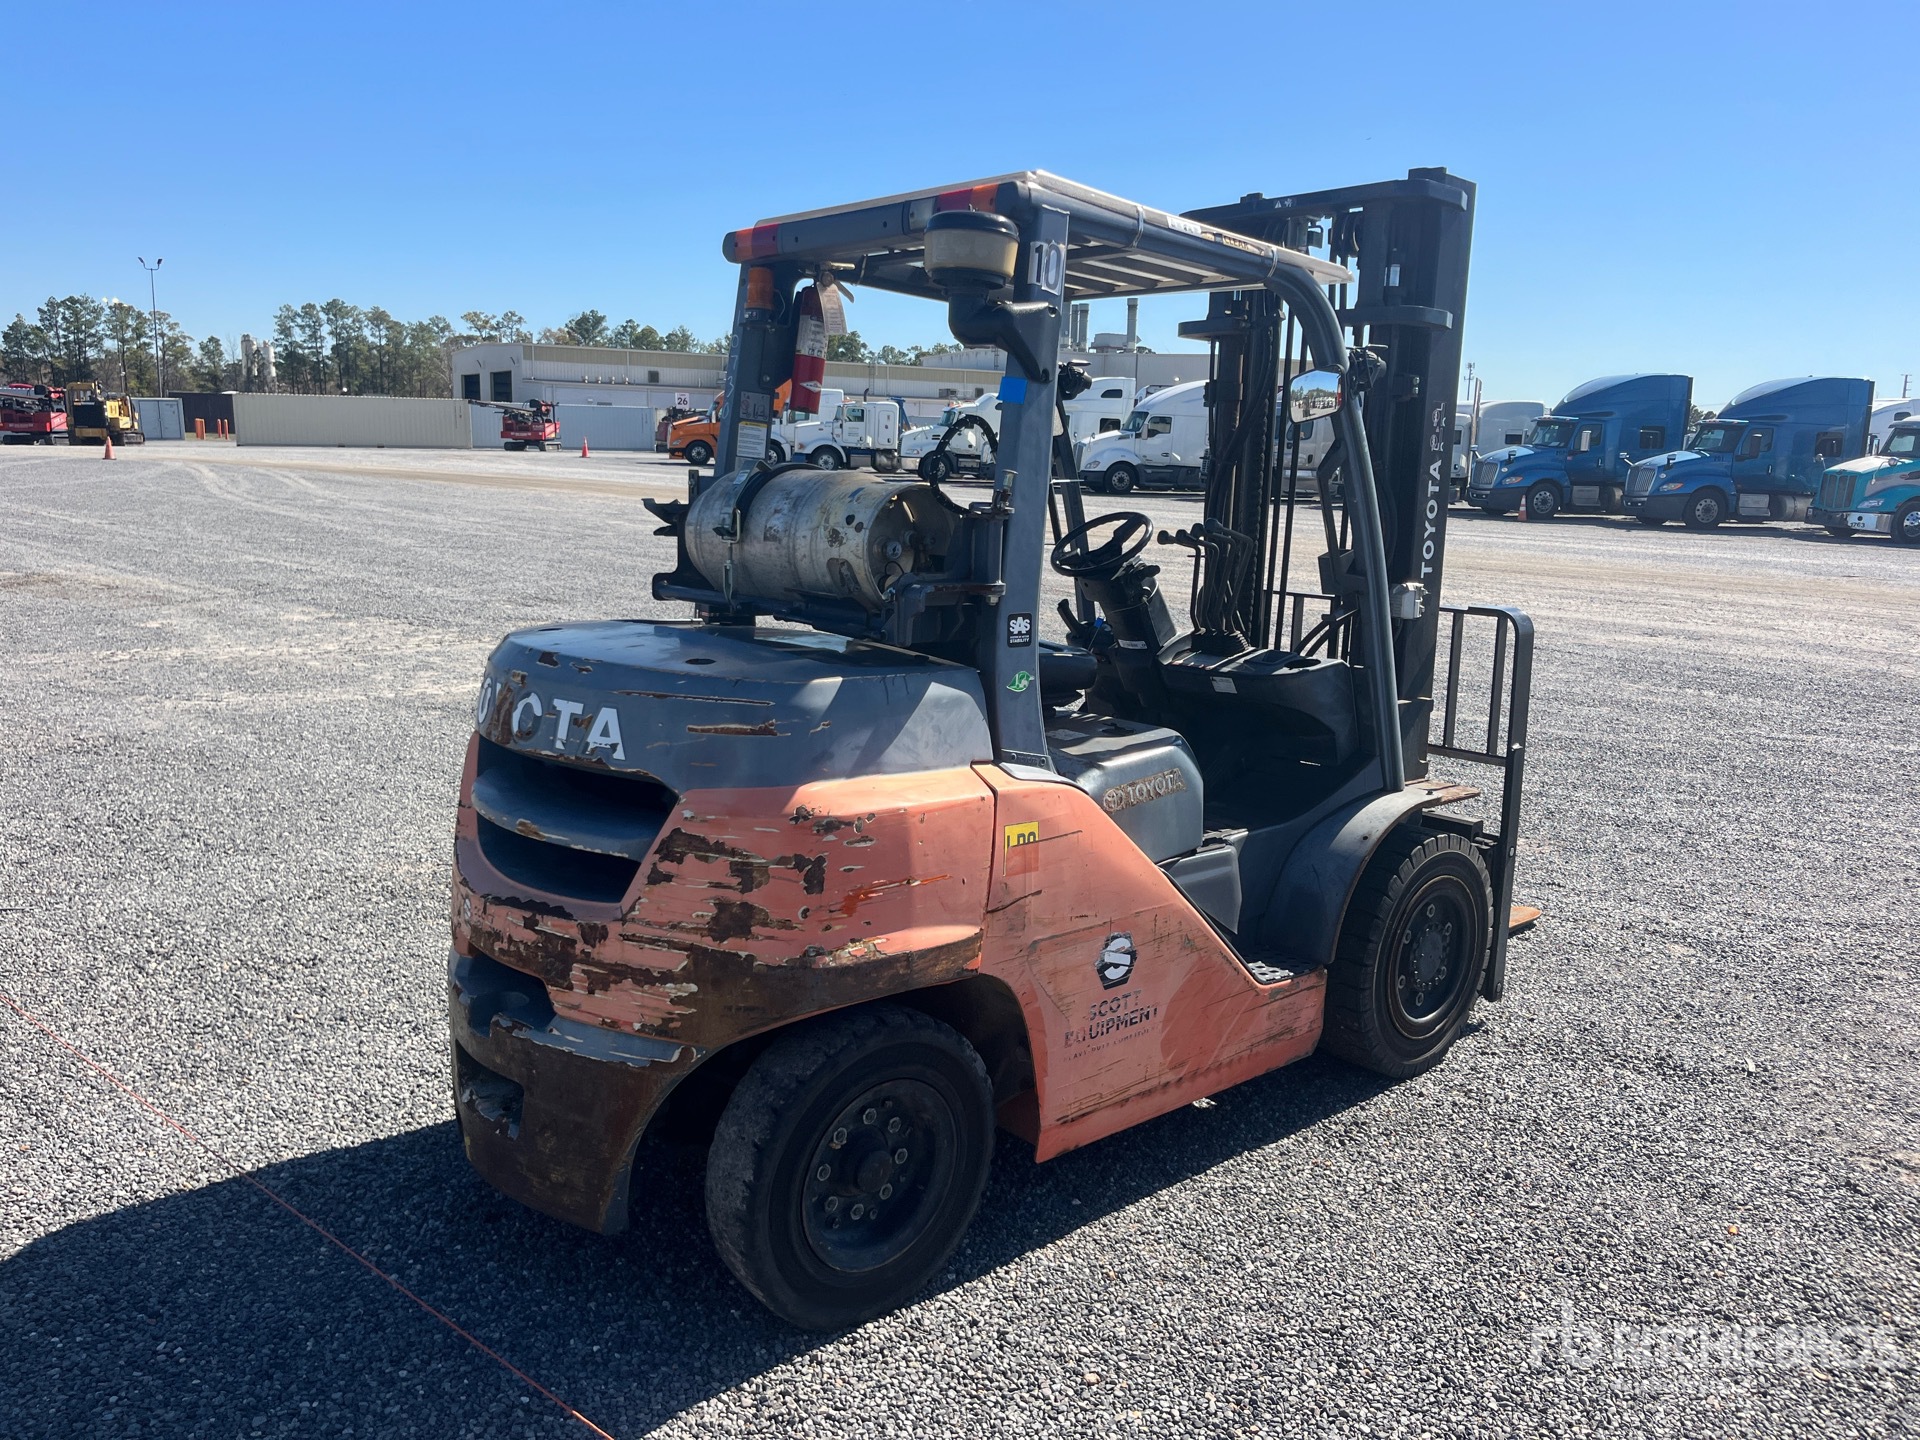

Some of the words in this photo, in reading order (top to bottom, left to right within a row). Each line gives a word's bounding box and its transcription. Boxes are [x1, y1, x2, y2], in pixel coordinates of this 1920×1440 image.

[1035, 244, 1061, 291] 10
[1421, 459, 1442, 578] TOYOTA
[1010, 616, 1030, 634] SAS
[1127, 768, 1185, 803] TOYOTA
[1089, 990, 1142, 1021] SCOTT
